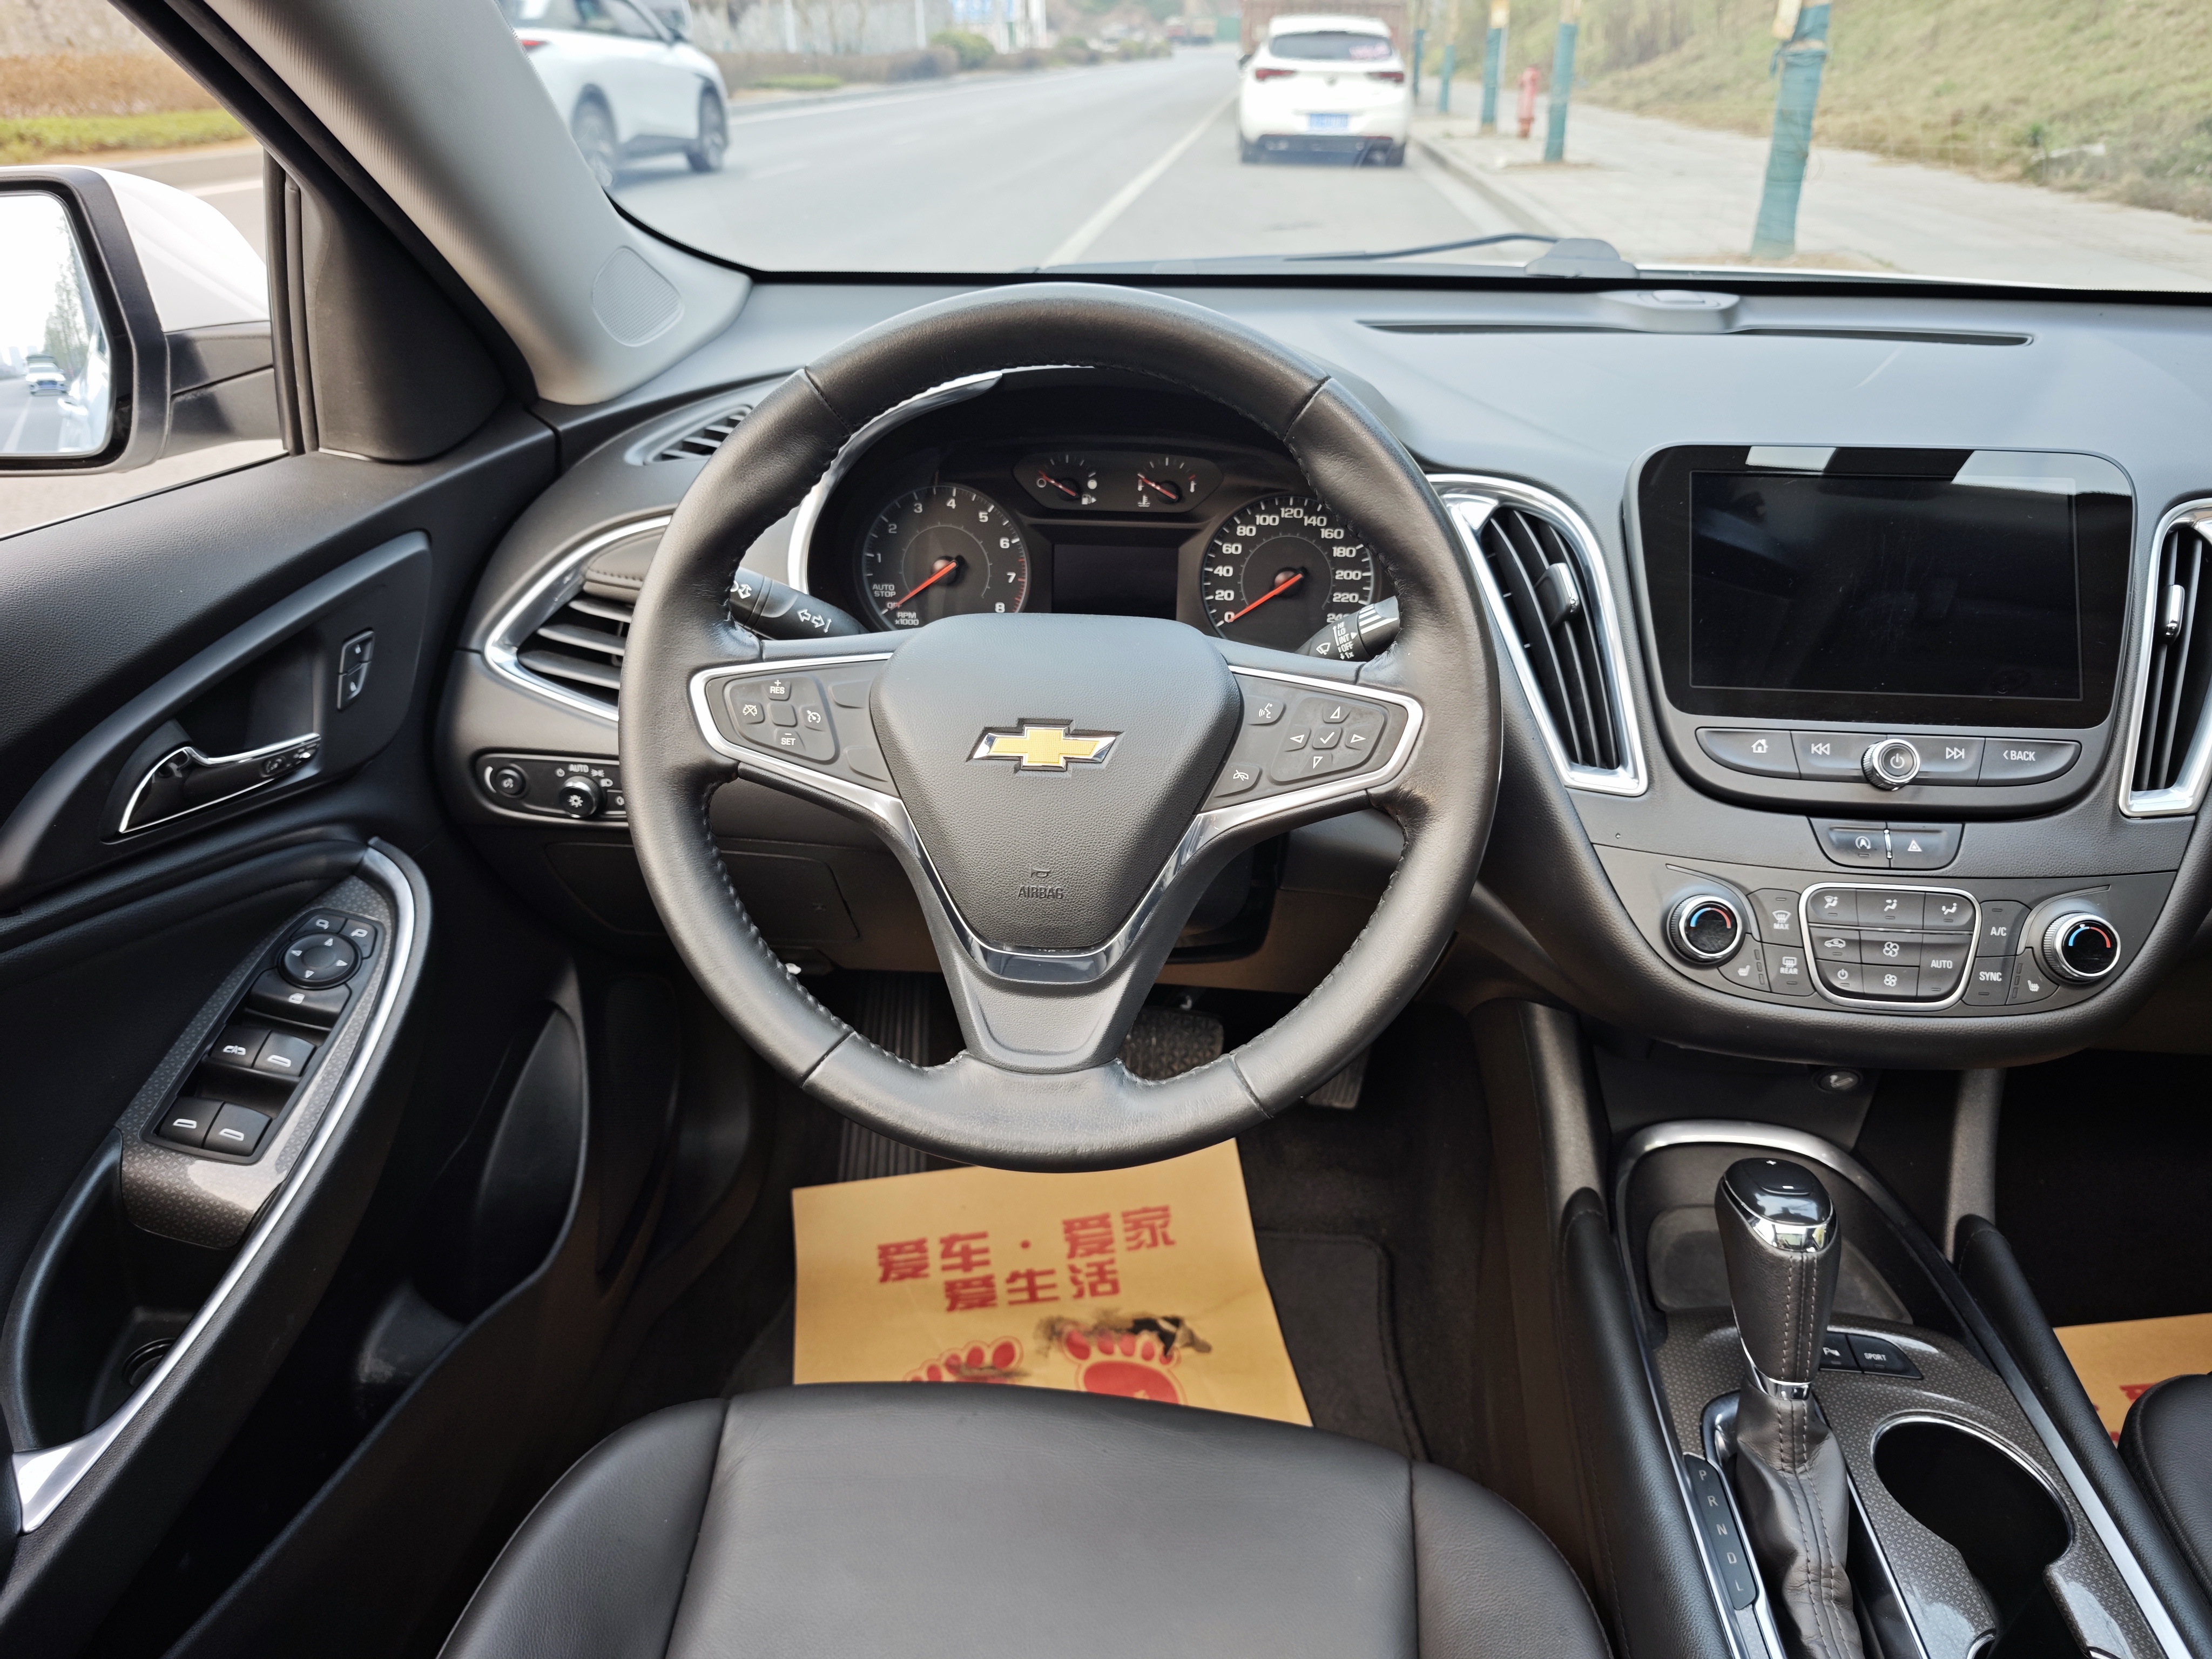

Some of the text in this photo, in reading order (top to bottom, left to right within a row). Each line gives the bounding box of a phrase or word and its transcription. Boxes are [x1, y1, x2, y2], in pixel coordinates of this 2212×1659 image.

[914, 503, 923, 513] 3
[947, 499, 956, 509] 4
[979, 511, 988, 522] 5
[1280, 508, 1304, 518] 120
[1255, 515, 1279, 526] 100
[1304, 516, 1326, 527] 140
[888, 524, 897, 534] 2
[1236, 526, 1256, 536] 80
[1320, 528, 1344, 539] 160
[1000, 538, 1010, 549] 6
[1222, 544, 1242, 554] 60
[1332, 547, 1356, 557] 180
[876, 554, 881, 562] 1
[1213, 566, 1233, 576] 40
[1335, 570, 1361, 581] 200
[1007, 572, 1016, 583] 7
[1215, 590, 1235, 601] 20
[1332, 592, 1359, 603] 220
[995, 602, 1005, 612] 8
[1224, 611, 1235, 622] 0
[1326, 613, 1350, 623] 24
[1338, 628, 1346, 636] LO
[1339, 633, 1350, 644] INT
[1341, 641, 1354, 652] OFF
[770, 686, 785, 694] RES
[2010, 750, 2035, 761] BACK
[568, 764, 589, 773] AUTO
[1018, 885, 1064, 899] AIRBAG
[1990, 927, 2007, 936] A/C
[1931, 960, 1953, 969] AUTO
[1979, 972, 2002, 982] SYNC
[943, 1258, 1121, 1313] 爱生活
[1864, 1352, 1887, 1361] SPORT
[1698, 1469, 1707, 1481] P
[1707, 1495, 1718, 1507] R
[1716, 1523, 1728, 1535] N
[1727, 1552, 1737, 1564] D
[1735, 1580, 1744, 1591] L
